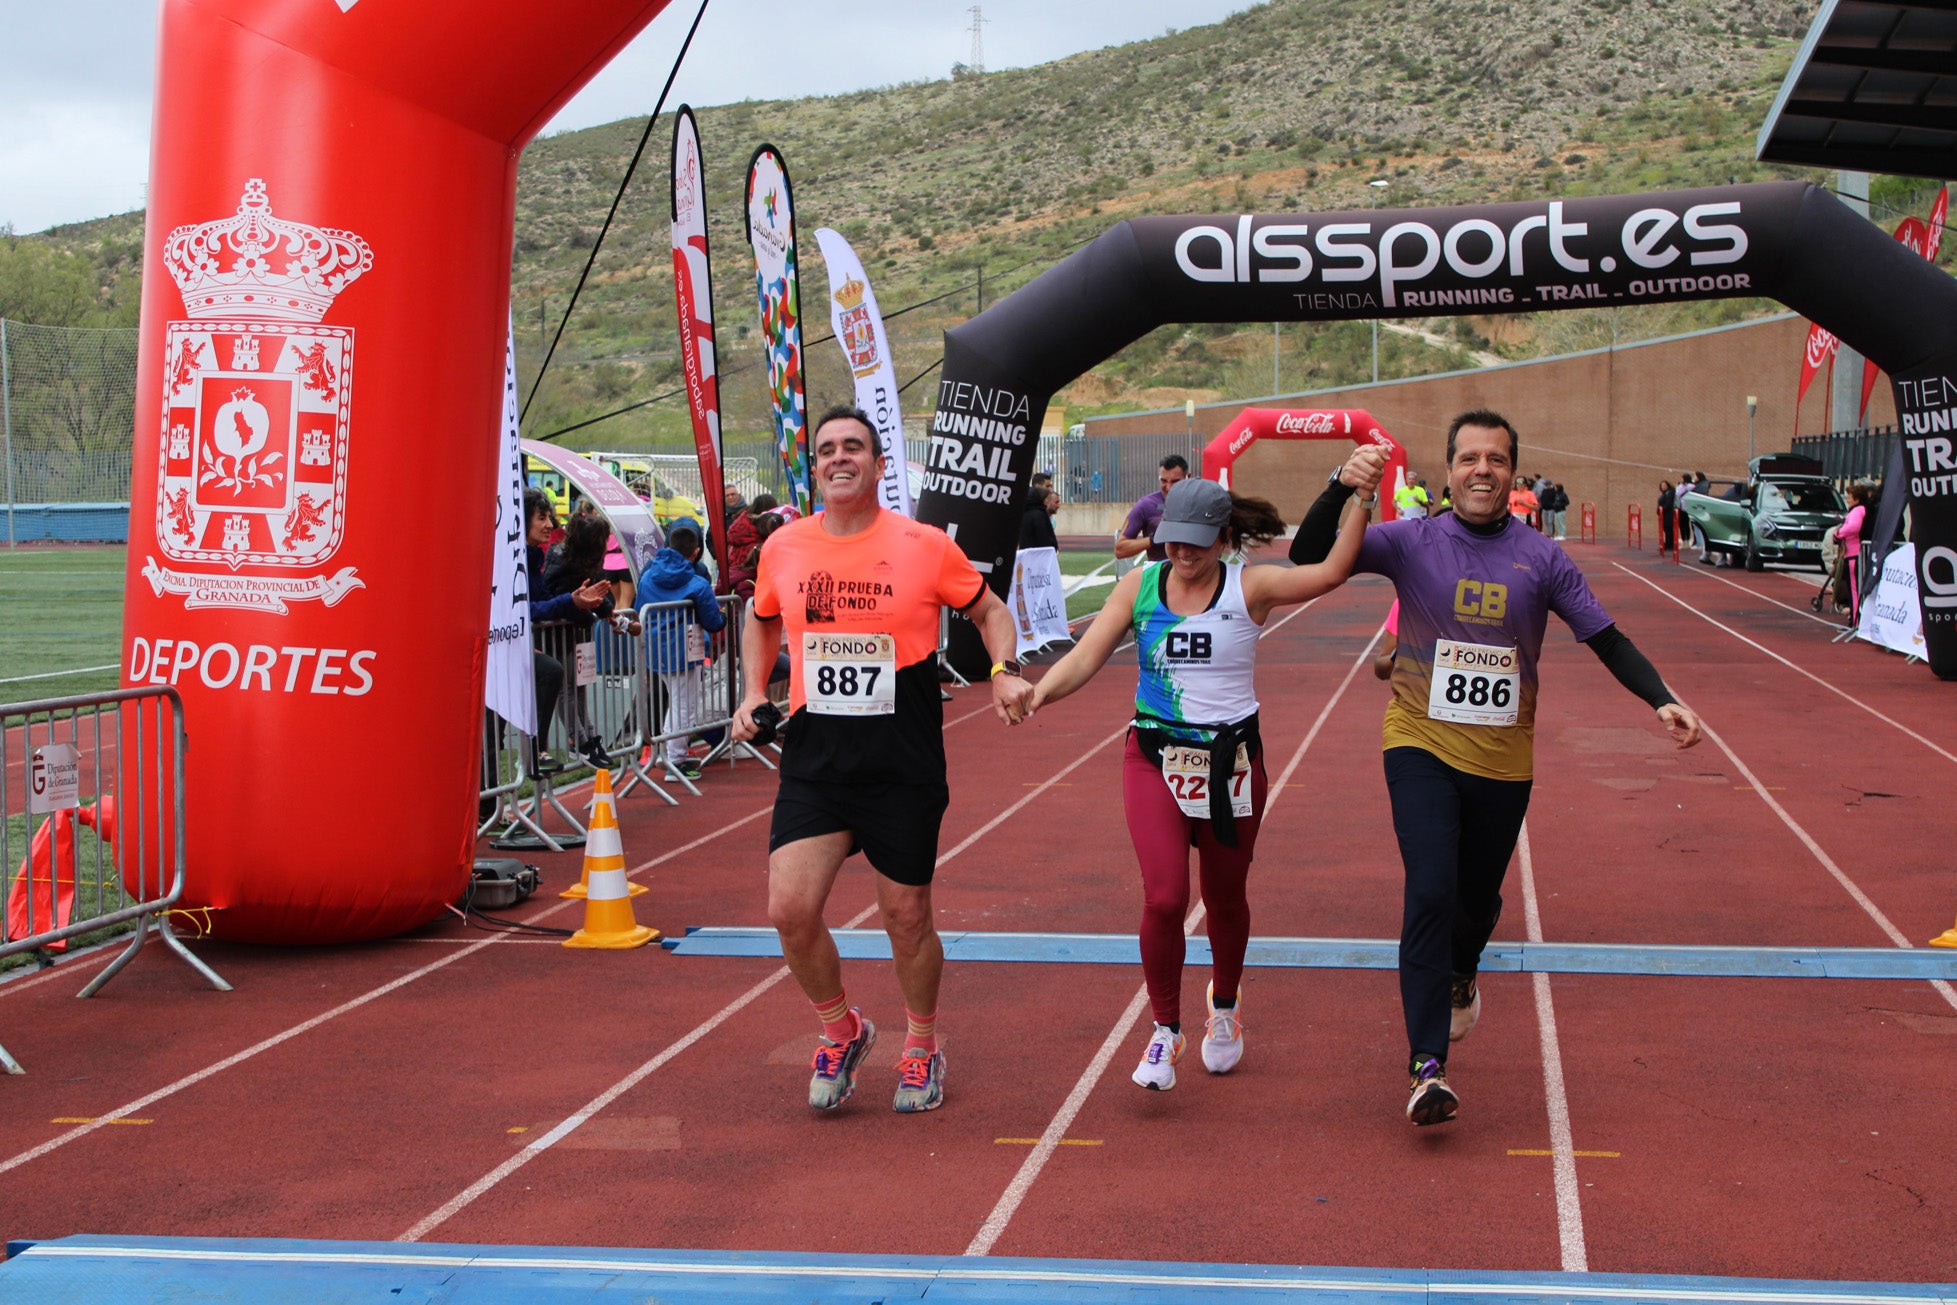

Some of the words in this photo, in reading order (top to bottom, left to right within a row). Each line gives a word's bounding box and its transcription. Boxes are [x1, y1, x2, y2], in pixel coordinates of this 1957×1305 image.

[1175, 201, 1749, 308] alssport.es
[1293, 292, 1378, 311] TIENDA
[1403, 287, 1514, 307] RUNNING
[1535, 283, 1608, 302] TRAIL
[1629, 273, 1752, 297] OUTDOOR
[940, 380, 1030, 422] TIENDA
[934, 410, 1027, 446] RUNNING
[1276, 413, 1336, 434] Coca-Cola
[928, 435, 1017, 482] TRAIL
[1905, 437, 1957, 474] TR
[922, 470, 1012, 506] OUTDOOR
[189, 576, 244, 591] DIPUTACION
[305, 579, 321, 592] DE
[196, 588, 271, 604] GRANADA
[797, 580, 834, 594] XXXII
[837, 581, 893, 597] PRUEBA
[1454, 579, 1508, 618] CB
[808, 594, 825, 610] DE
[829, 595, 877, 611] FONDO
[822, 641, 877, 655] FONDO
[1166, 632, 1212, 659] CB
[1456, 650, 1512, 667] FONDO
[130, 636, 377, 697] DEPORTES
[817, 665, 881, 697] 887
[1445, 673, 1512, 708] 886
[1183, 755, 1211, 767] FON
[1168, 770, 1248, 800] 227
